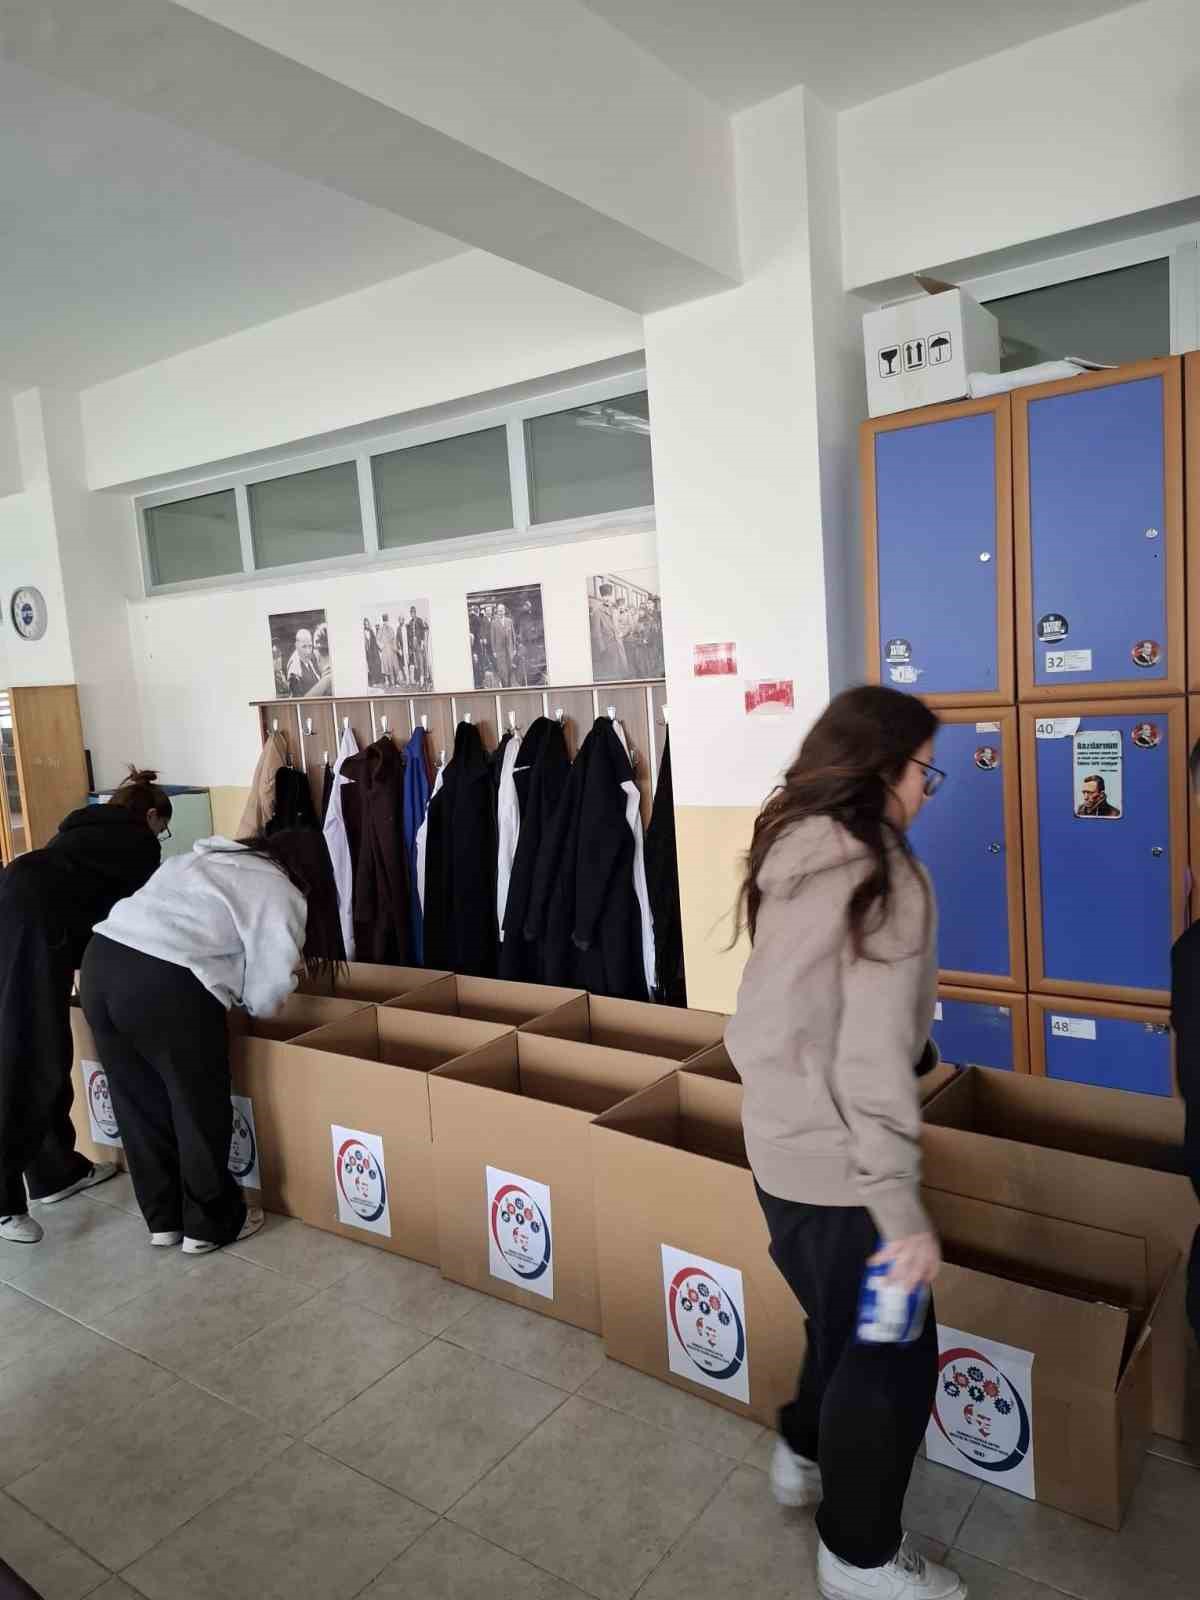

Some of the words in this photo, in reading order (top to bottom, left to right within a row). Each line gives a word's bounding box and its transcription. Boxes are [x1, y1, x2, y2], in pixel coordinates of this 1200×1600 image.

[1047, 656, 1064, 668] 32
[1037, 723, 1053, 734] 40
[1054, 1021, 1069, 1032] 48
